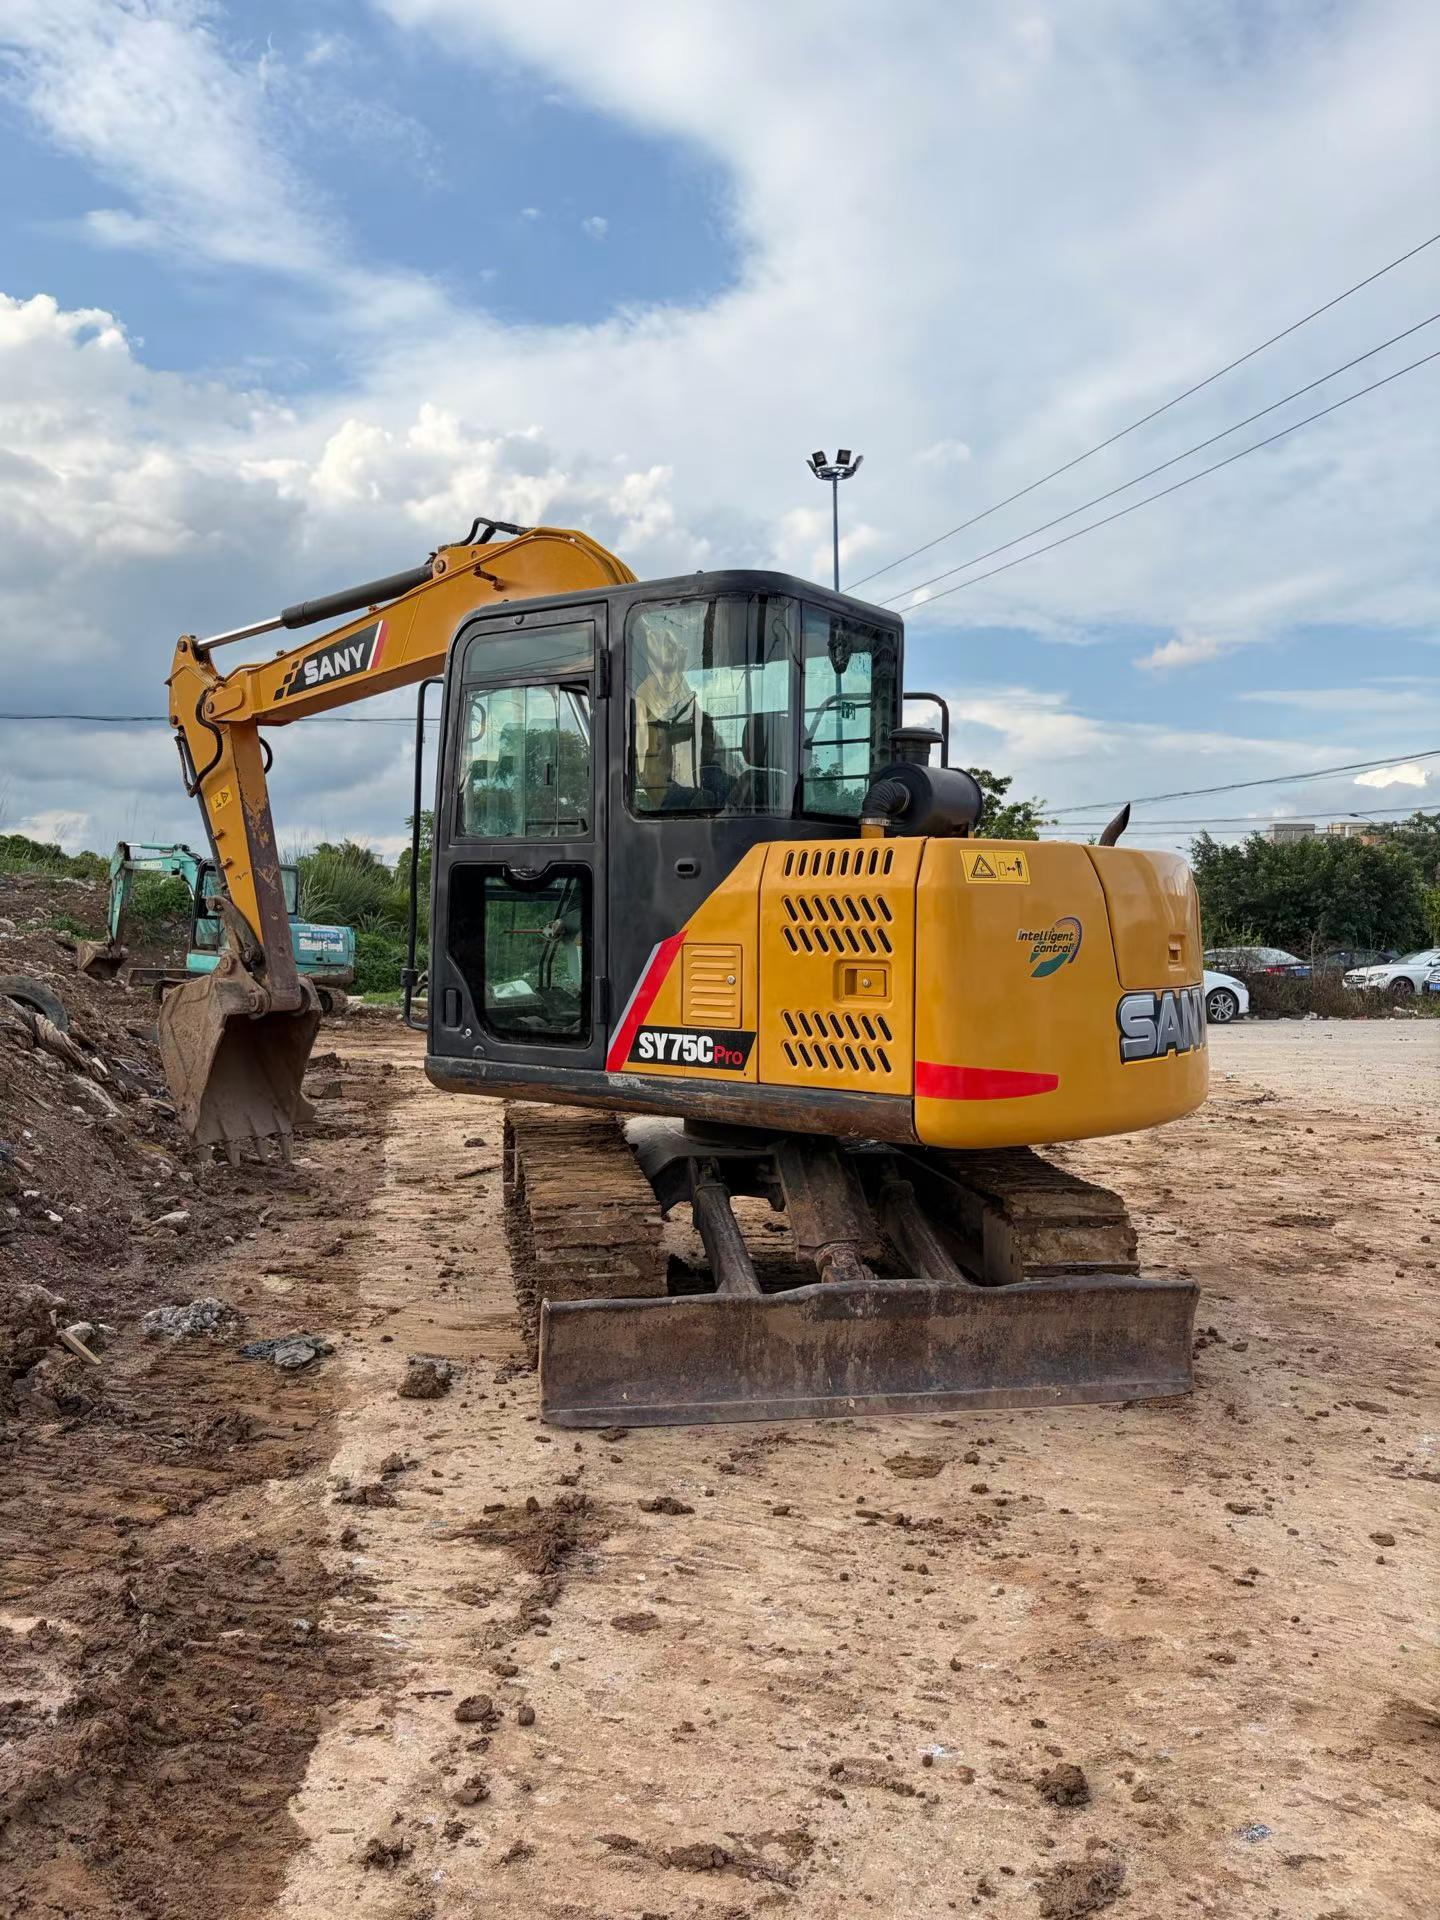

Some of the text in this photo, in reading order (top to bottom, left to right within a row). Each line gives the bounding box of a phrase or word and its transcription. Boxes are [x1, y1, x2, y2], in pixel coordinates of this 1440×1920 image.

[304, 642, 365, 685] SANY
[1018, 928, 1074, 943] intelligent
[1033, 943, 1072, 953] control
[638, 1031, 743, 1065] SY75C Pro
